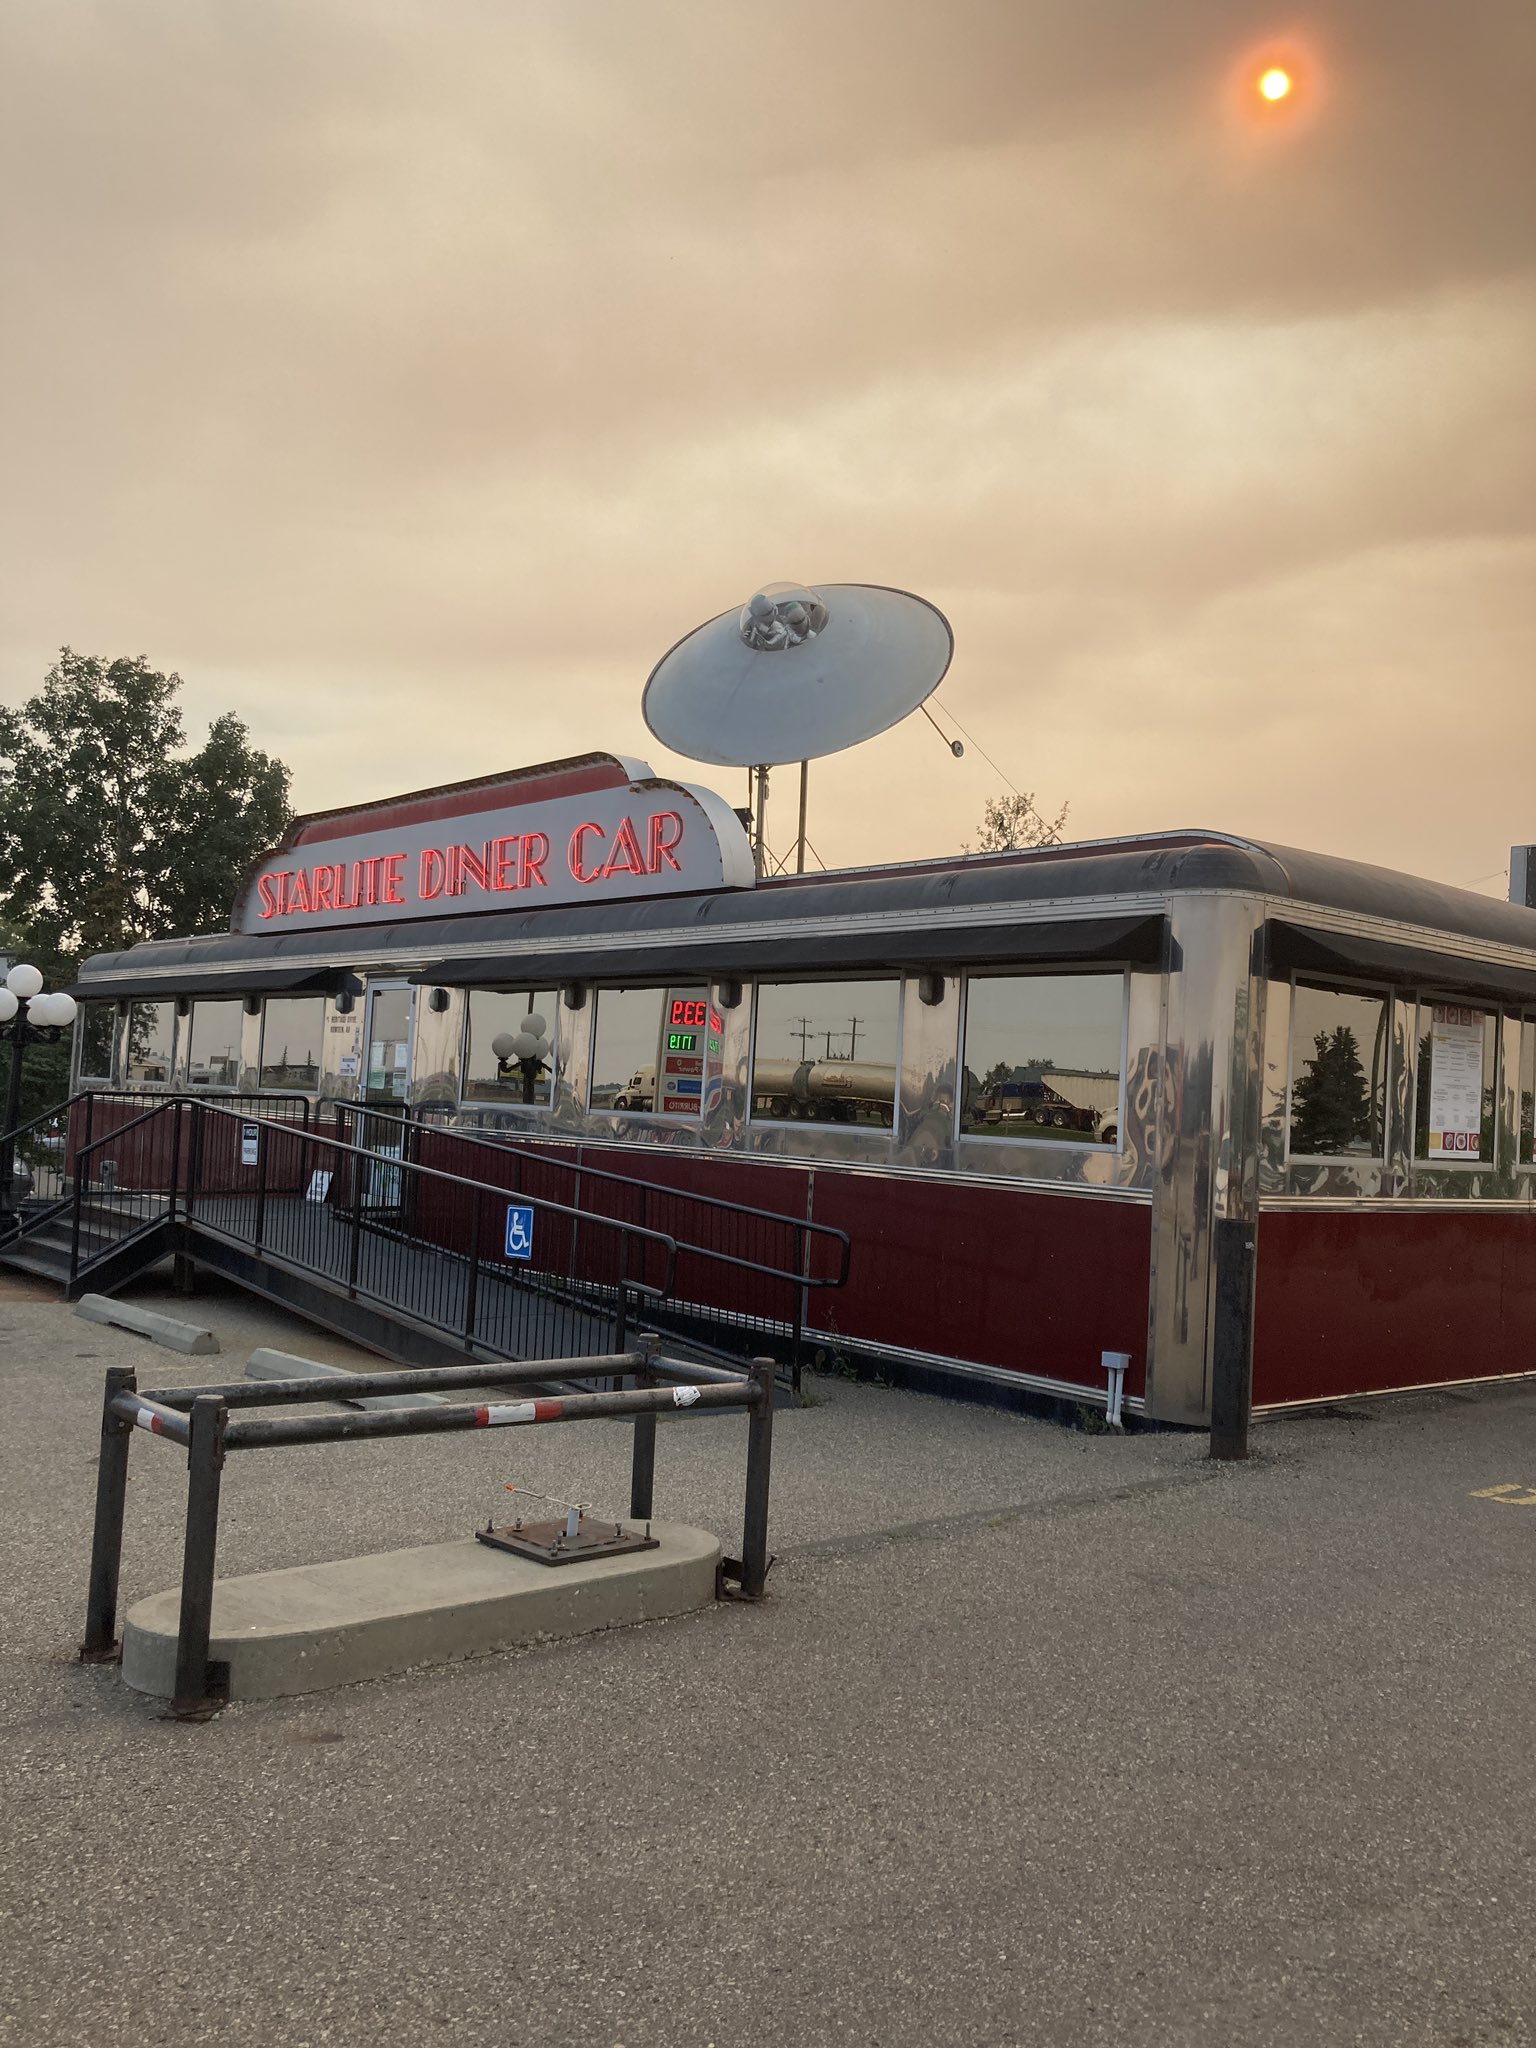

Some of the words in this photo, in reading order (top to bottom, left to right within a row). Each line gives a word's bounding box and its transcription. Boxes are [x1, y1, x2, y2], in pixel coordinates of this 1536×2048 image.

[257, 854, 408, 919] STARLITE
[418, 832, 550, 900] DINER
[567, 811, 684, 884] CAR
